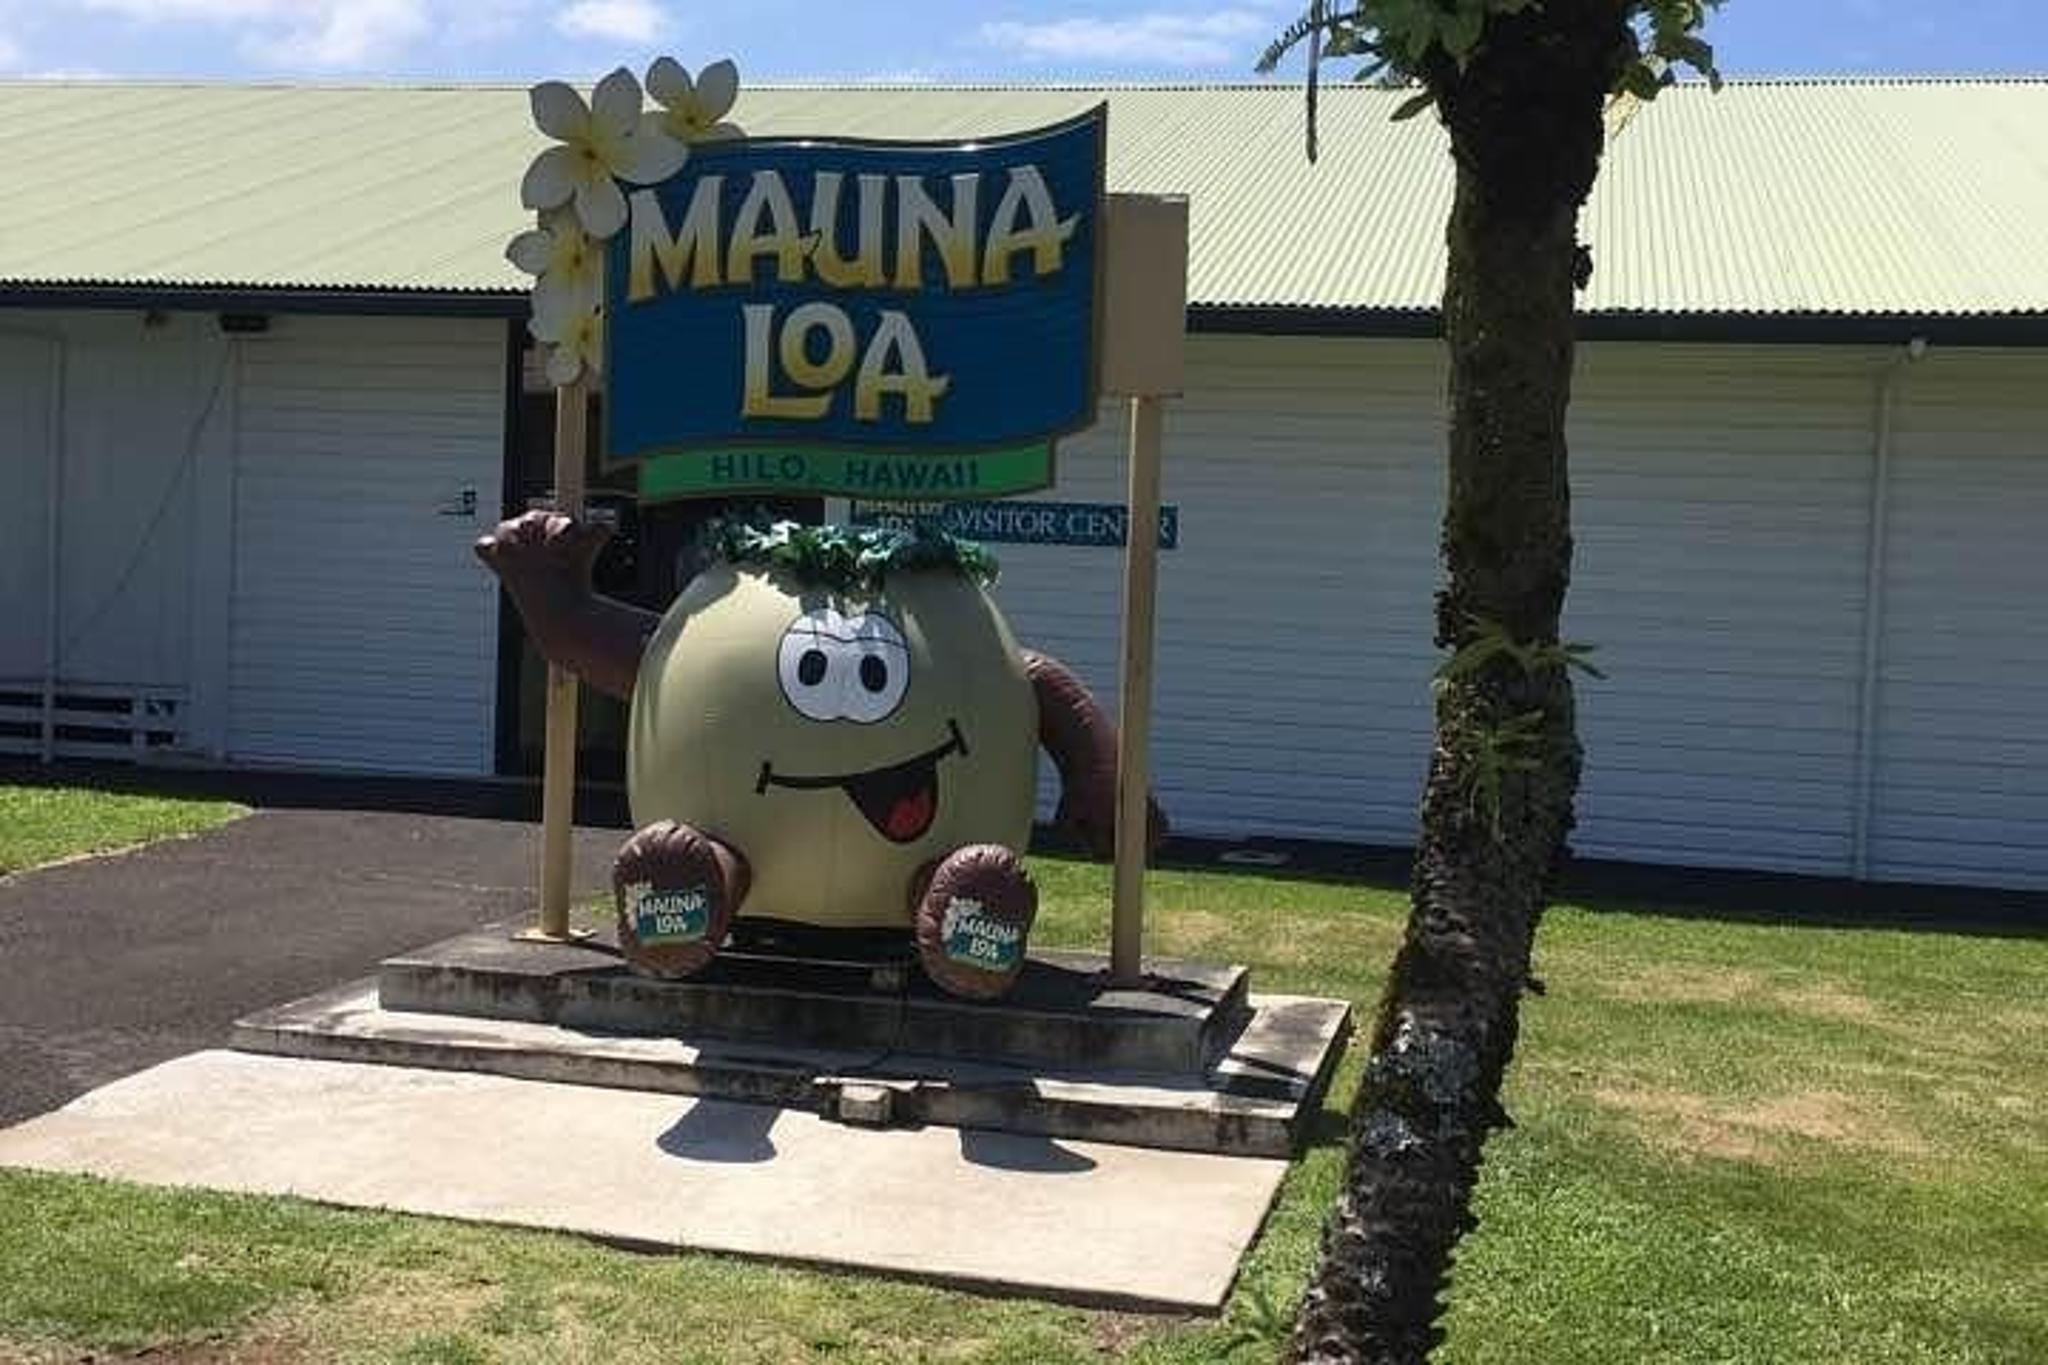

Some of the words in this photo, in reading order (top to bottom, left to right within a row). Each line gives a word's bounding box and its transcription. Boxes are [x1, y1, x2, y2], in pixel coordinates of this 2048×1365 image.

[626, 163, 1081, 301] MAUNA
[741, 301, 951, 423] LOA
[844, 458, 980, 489] HAWAII
[956, 504, 1056, 534] VISITOR
[1066, 510, 1170, 540] CENR
